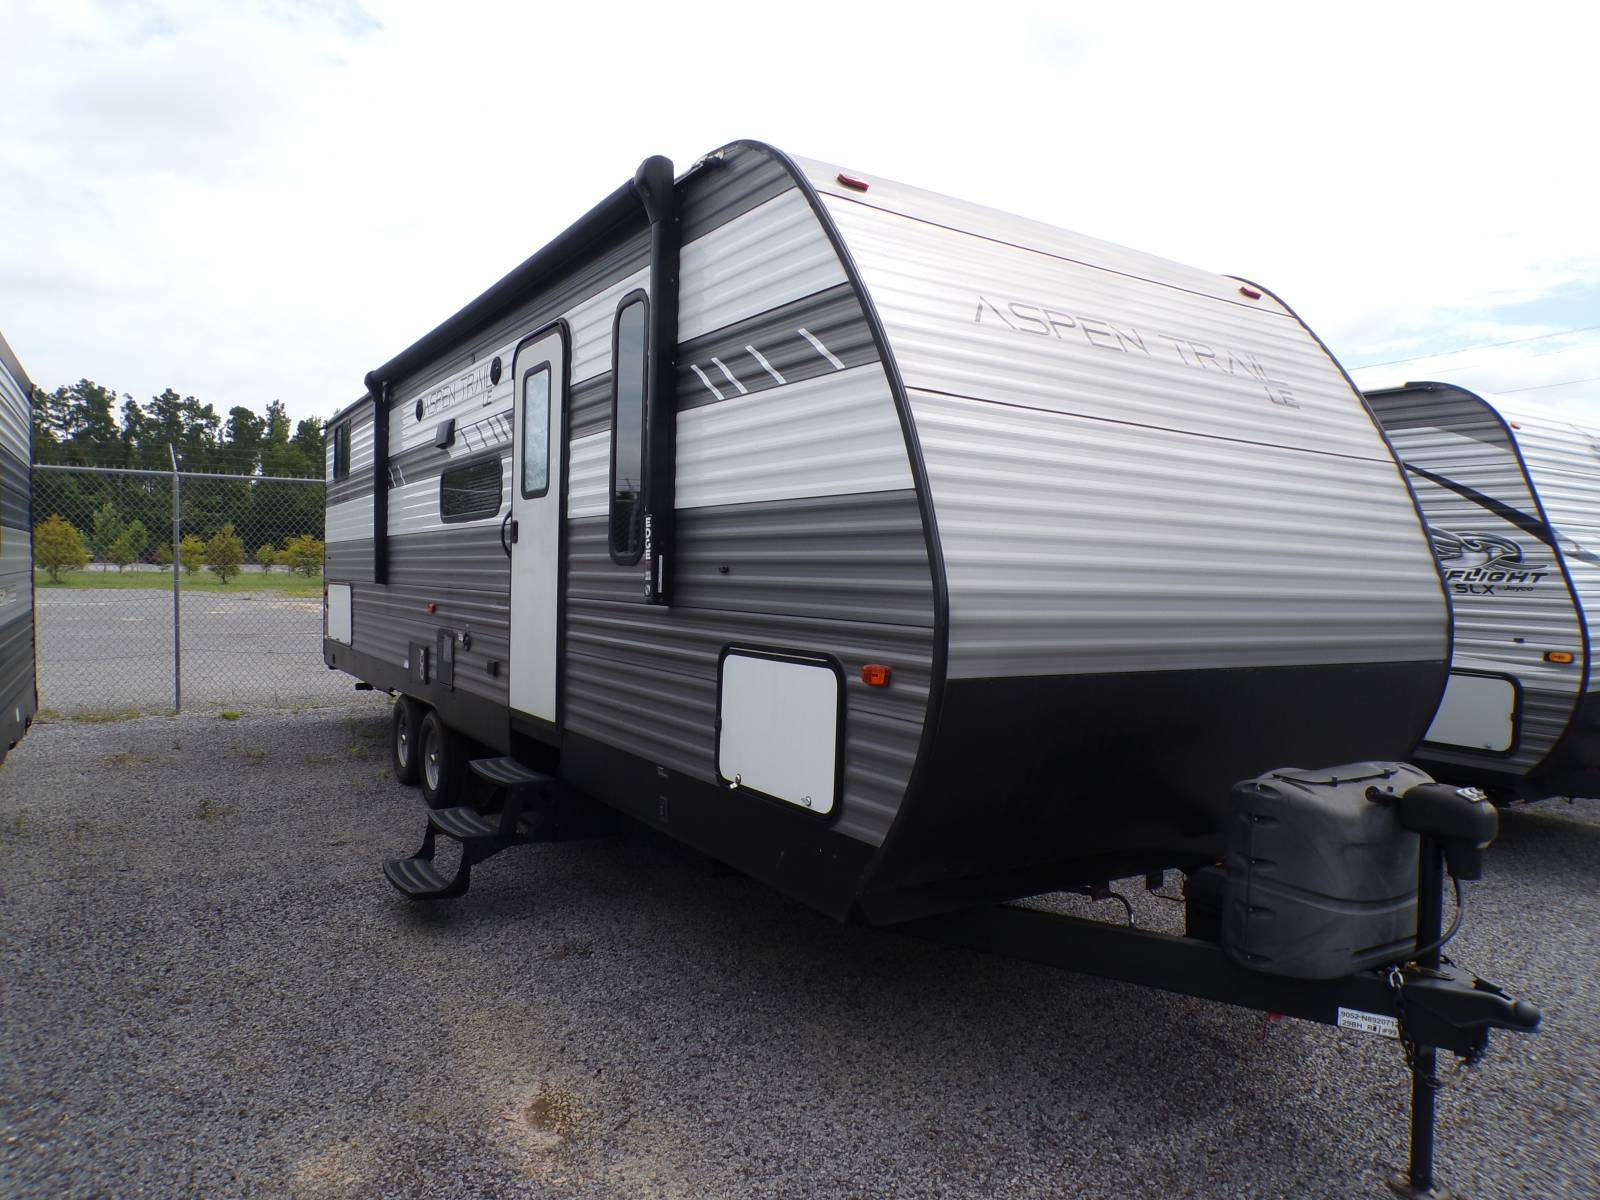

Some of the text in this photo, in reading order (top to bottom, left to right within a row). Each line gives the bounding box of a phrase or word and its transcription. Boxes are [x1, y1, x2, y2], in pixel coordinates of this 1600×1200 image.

[974, 295, 1289, 385] ASPEN TRAIL
[1445, 569, 1548, 583] FLIGHT
[1455, 583, 1495, 595] SLX
[1504, 585, 1534, 593] Jayco
[1342, 1019, 1363, 1030] 29BH
